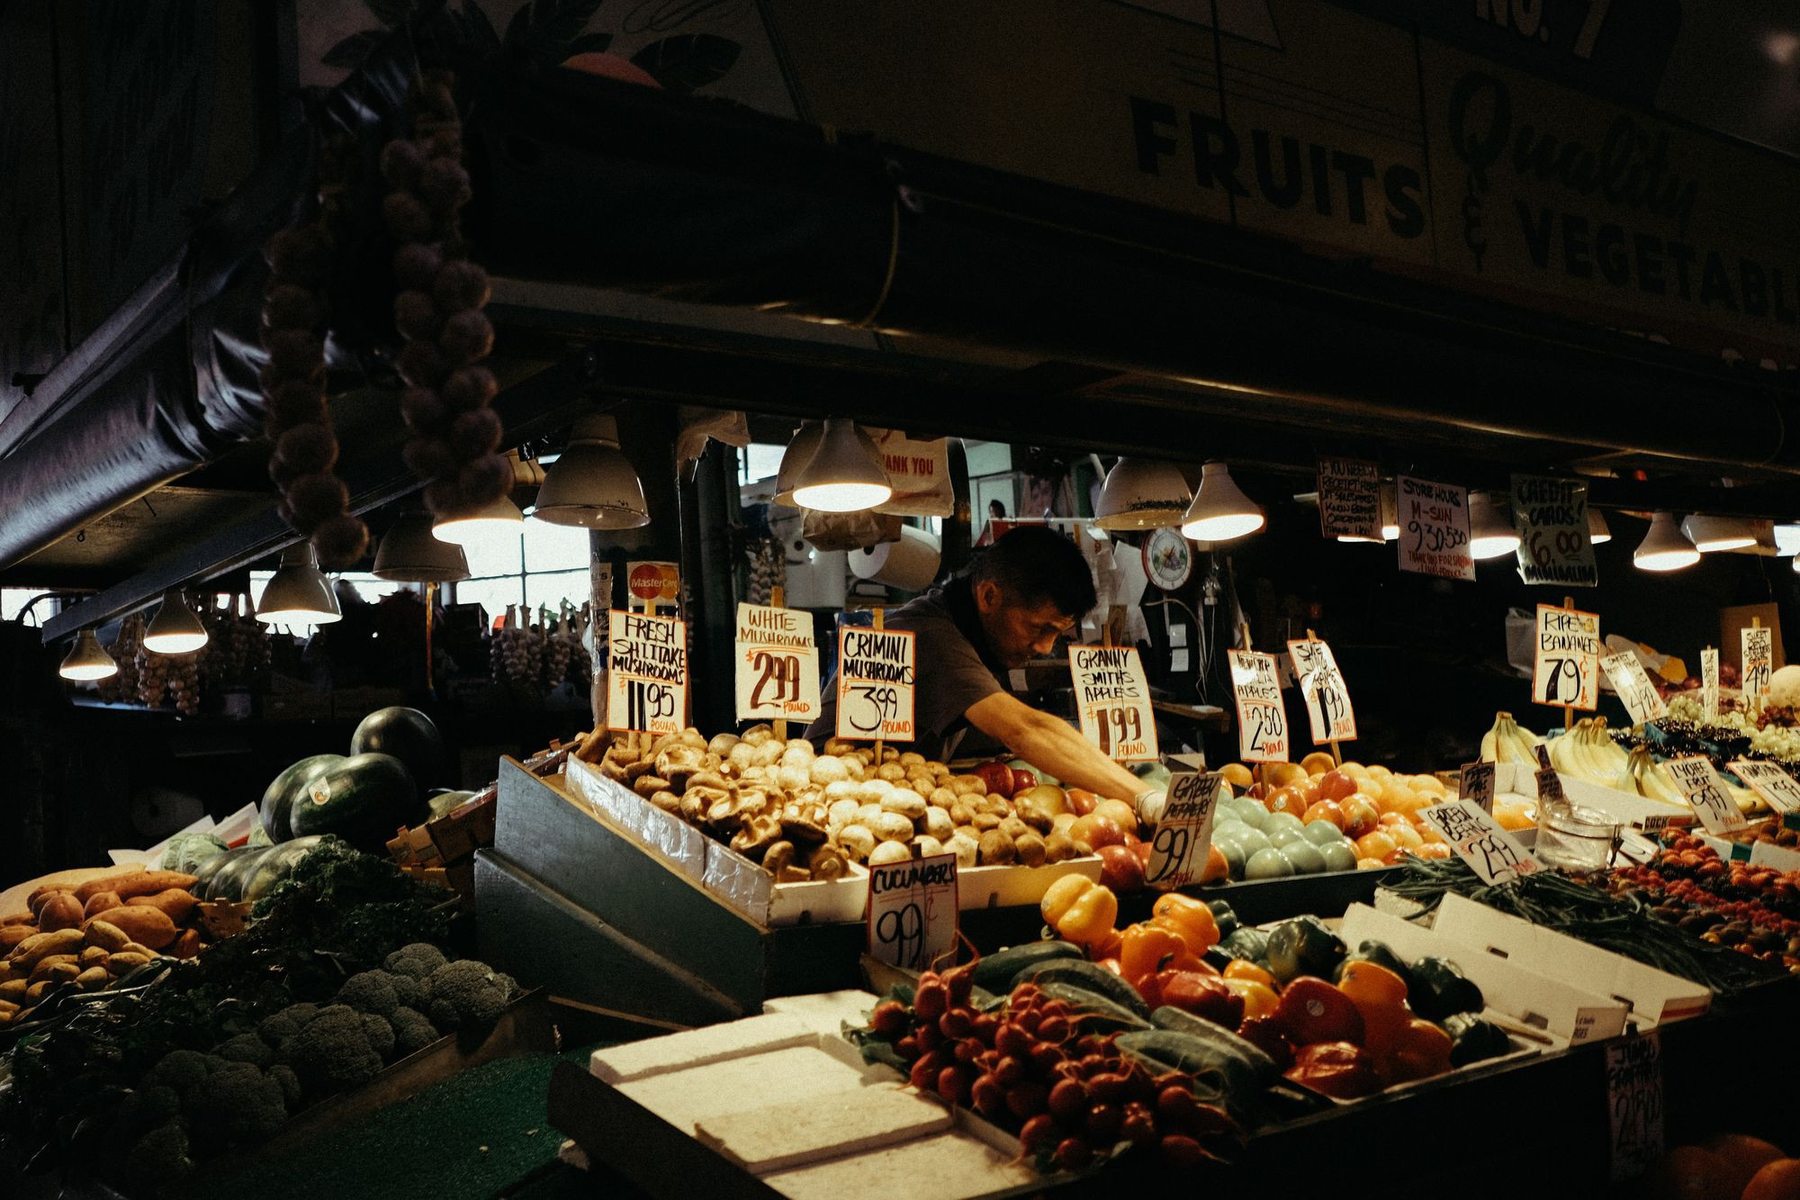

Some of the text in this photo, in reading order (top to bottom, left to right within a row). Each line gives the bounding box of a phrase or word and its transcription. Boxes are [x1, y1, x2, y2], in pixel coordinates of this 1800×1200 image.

[1449, 69, 1696, 240] Quality
[1130, 96, 1427, 239] FRUITS
[1461, 196, 1800, 323] & VEGETABL
[911, 456, 934, 475] YOU
[1402, 478, 1433, 499] STORE
[1434, 486, 1461, 508] HOURS
[625, 615, 676, 646] FRESH
[748, 609, 797, 632] WHITE
[1544, 612, 1579, 632] RIPE
[740, 626, 813, 648] MUSHROOMS
[843, 632, 907, 664] CRIMINI
[1541, 633, 1600, 656] BANANAS
[611, 654, 685, 686] MUSHROOMS
[1076, 648, 1130, 671] GRANNY
[842, 658, 915, 686] MUSHROOMS
[1080, 670, 1135, 686] SMITHS
[1084, 686, 1141, 703] APPLES
[1237, 684, 1278, 699] APPLES
[783, 701, 811, 714] POUND
[881, 719, 912, 734] POUND
[1118, 742, 1147, 757] POUND
[1173, 775, 1221, 801] GREEN
[1427, 803, 1474, 829] GREEN
[1443, 816, 1492, 842] BEANS
